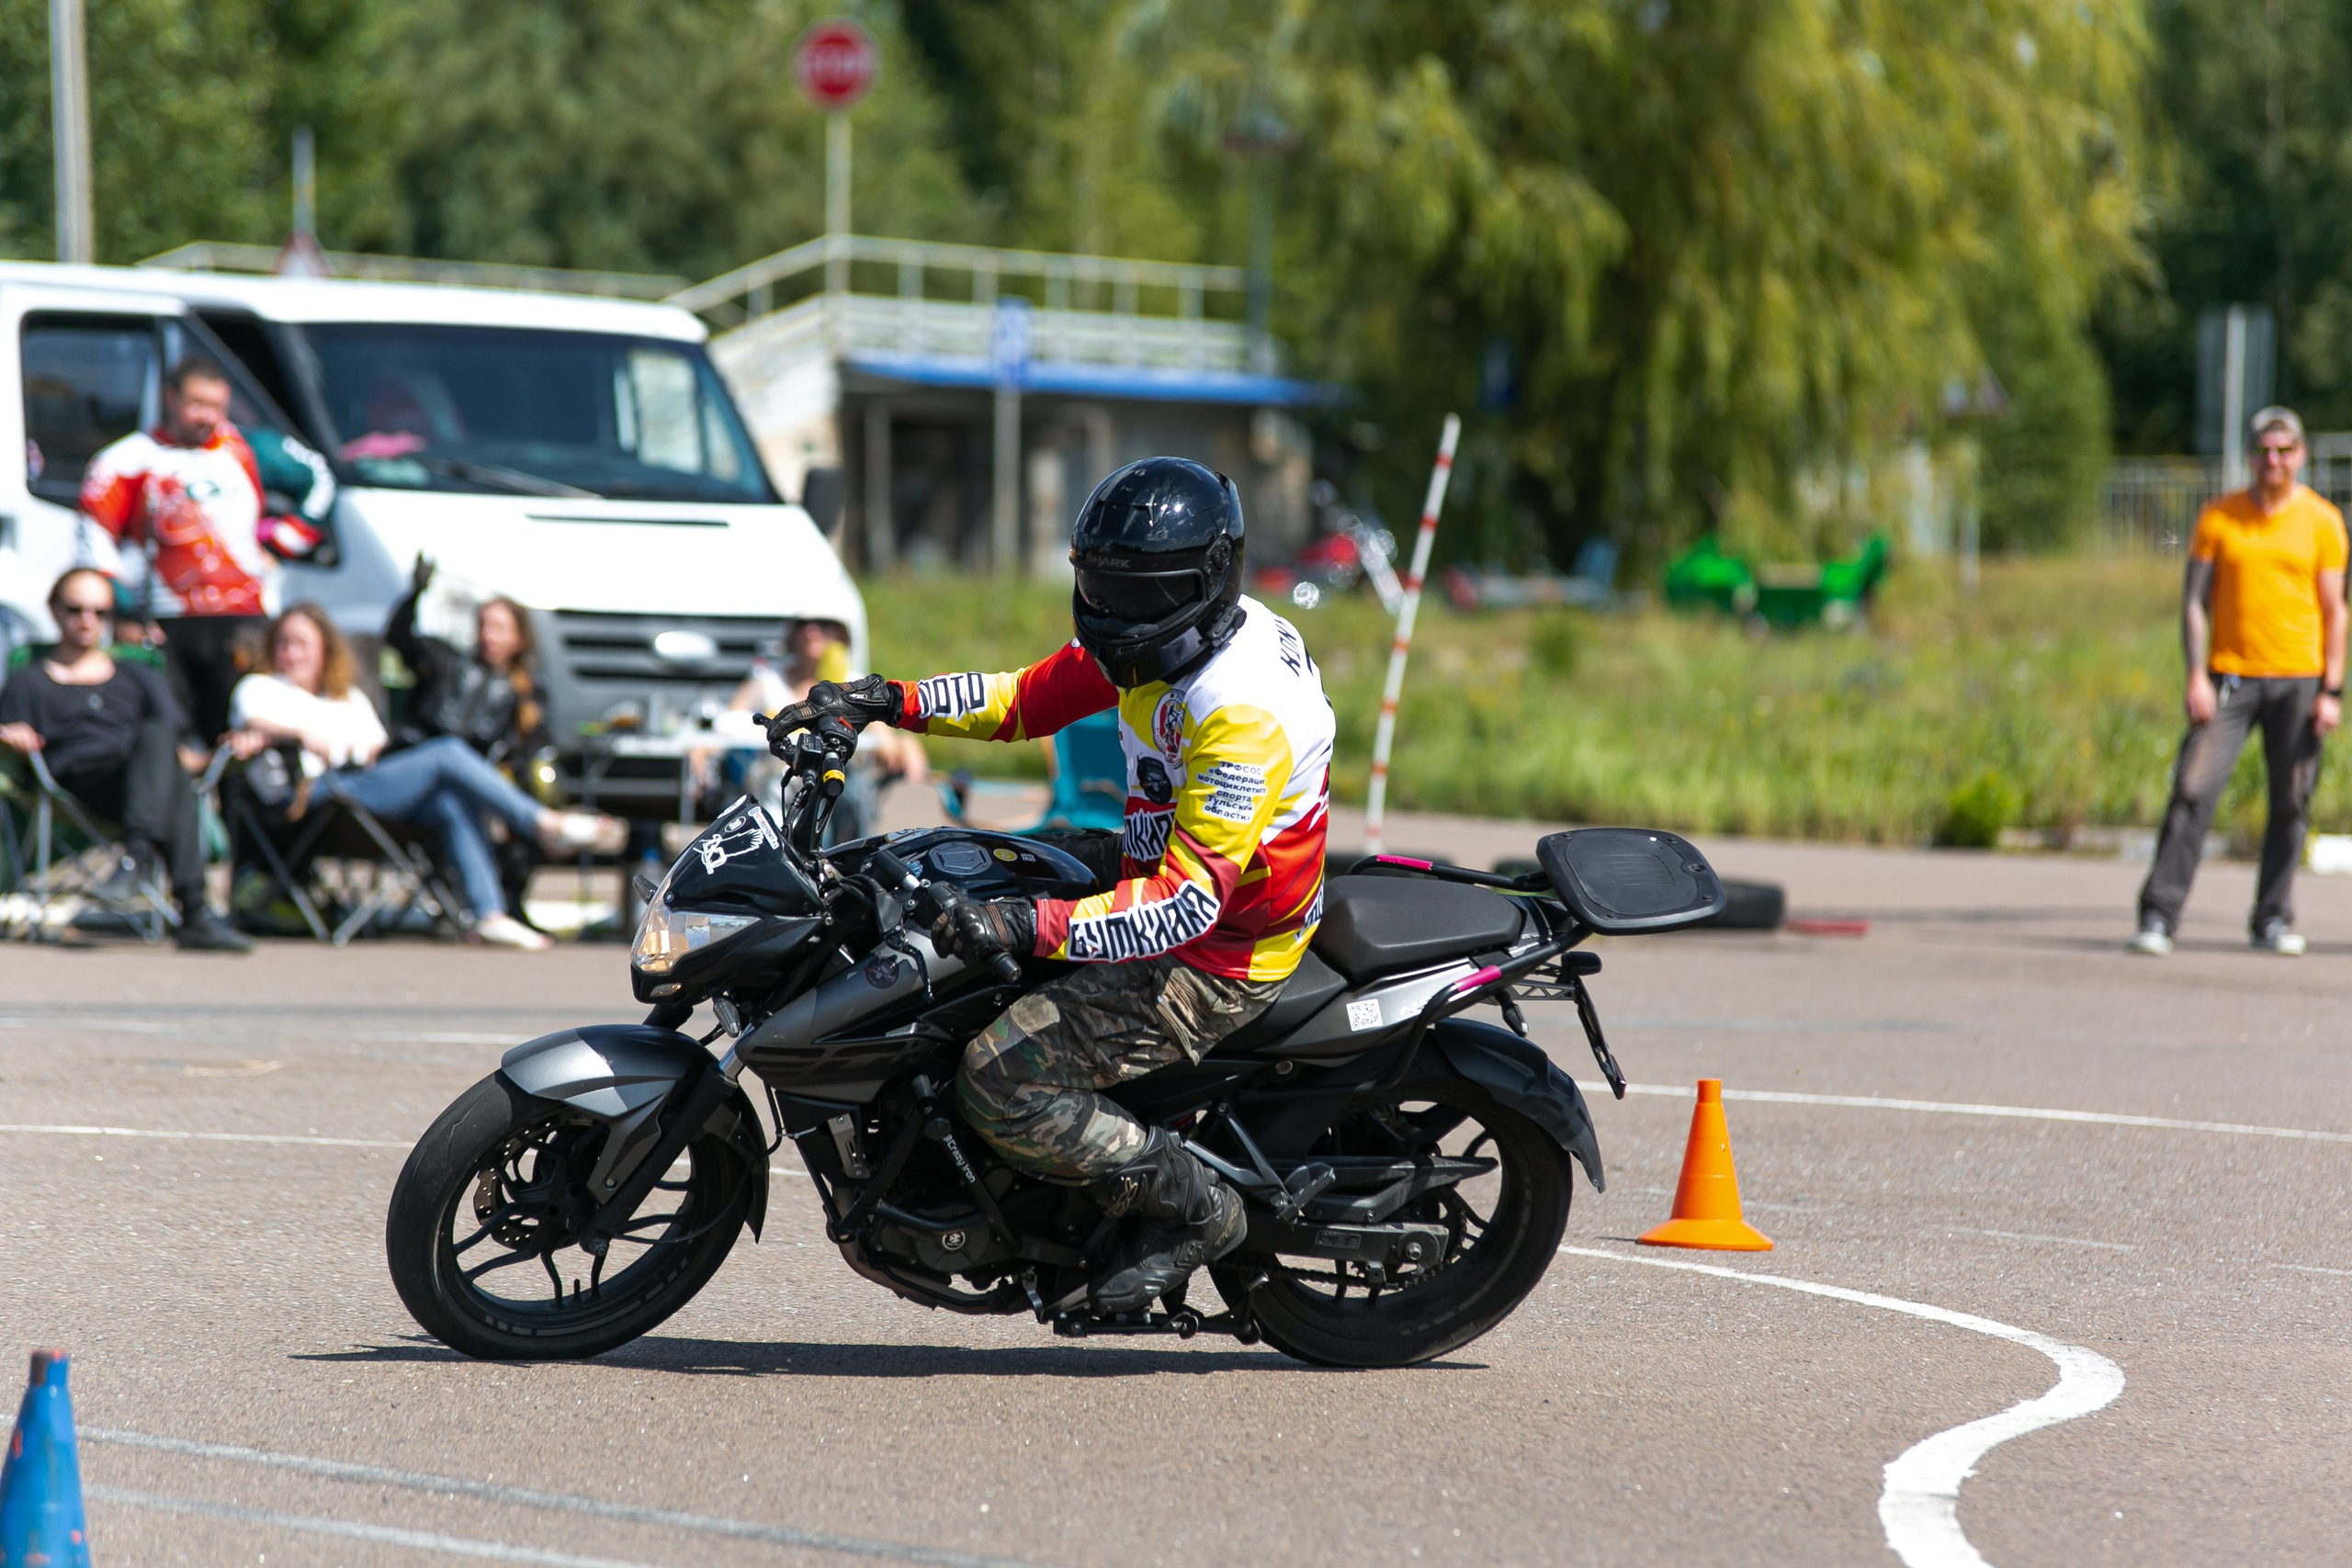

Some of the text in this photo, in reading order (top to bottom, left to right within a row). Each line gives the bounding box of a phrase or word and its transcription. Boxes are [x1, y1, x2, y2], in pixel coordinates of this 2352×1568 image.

[1086, 554, 1130, 569] SHARK
[947, 1139, 976, 1184] Crazy Iron
